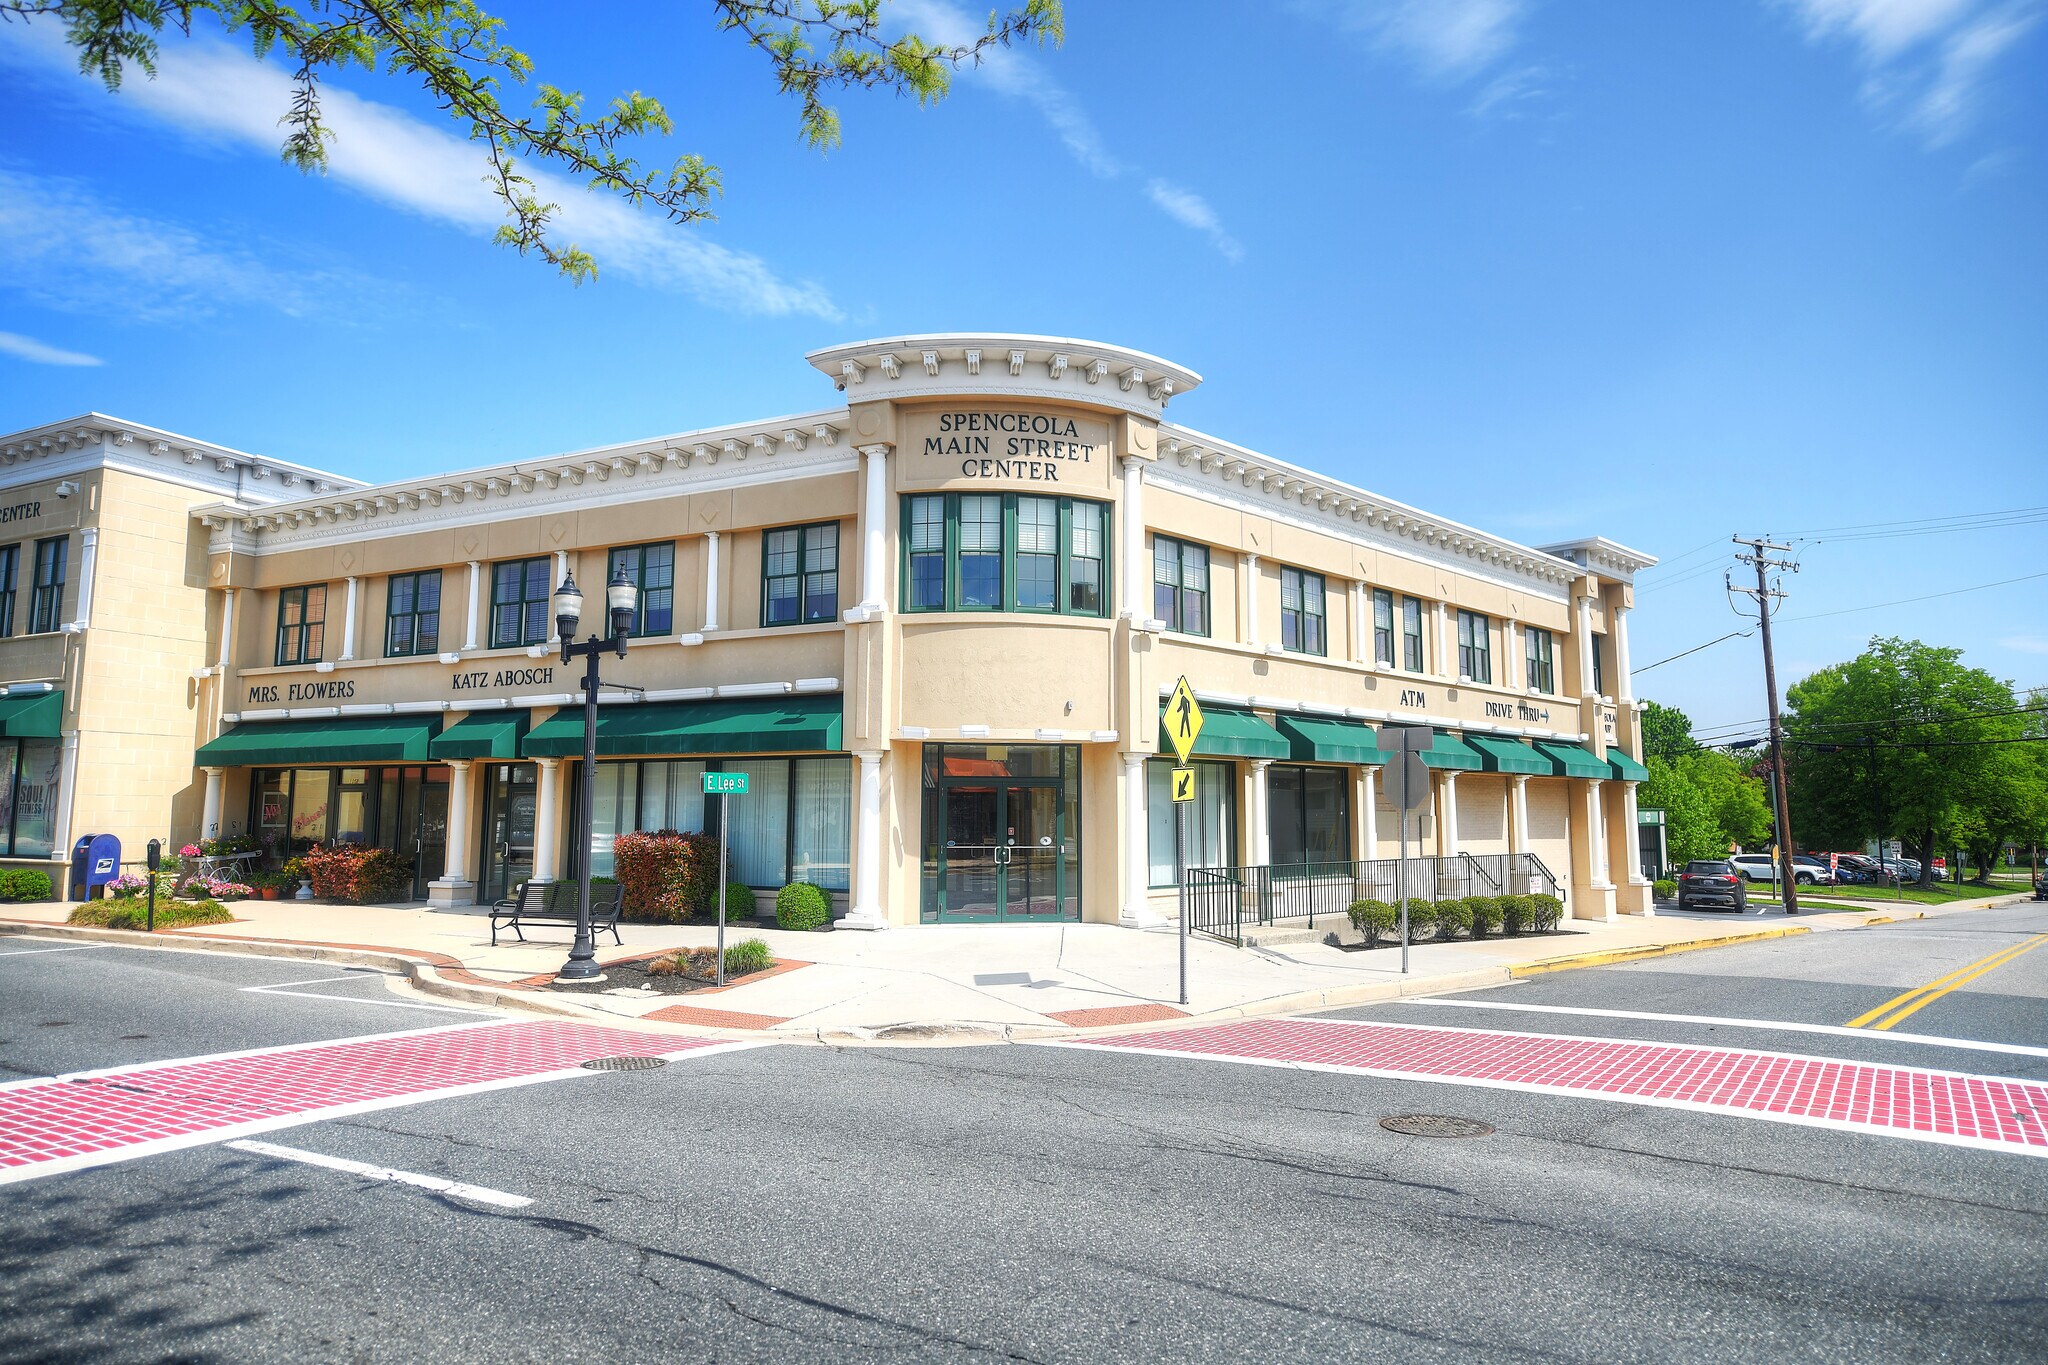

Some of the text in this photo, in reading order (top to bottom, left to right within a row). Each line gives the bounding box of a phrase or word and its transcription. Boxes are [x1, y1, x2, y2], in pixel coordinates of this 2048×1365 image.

[940, 413, 1079, 438] SPENCEOLA
[924, 436, 1094, 462] MAIN STREET
[962, 459, 1059, 481] CENTER
[452, 668, 553, 689] KATZ ABOSCH
[248, 680, 355, 703] MRS. FLOWERS
[1399, 689, 1426, 709] ATM
[1485, 701, 1540, 722] DRIVE THRU
[718, 775, 735, 790] Lee
[737, 778, 745, 788] St
[20, 784, 43, 803] SOUL
[18, 803, 42, 814] FITNESS
